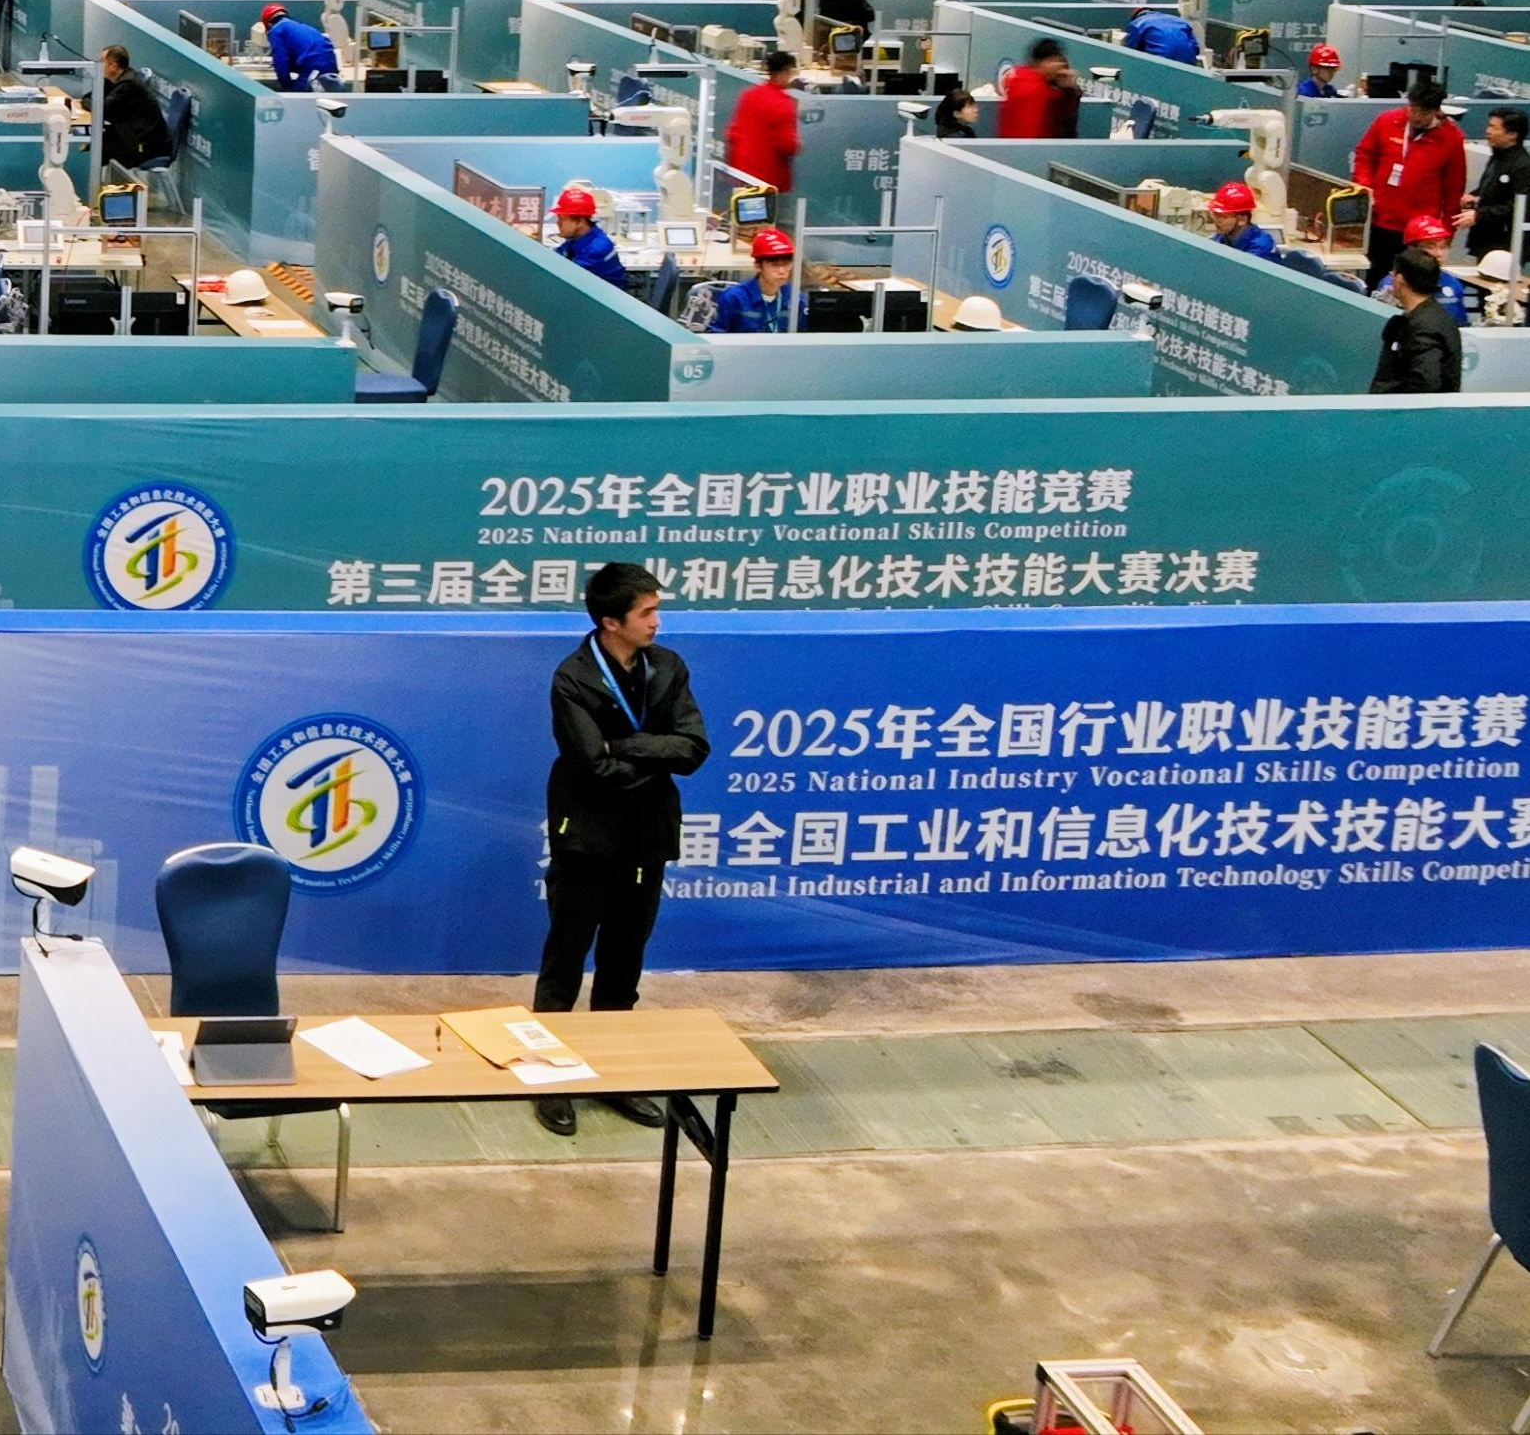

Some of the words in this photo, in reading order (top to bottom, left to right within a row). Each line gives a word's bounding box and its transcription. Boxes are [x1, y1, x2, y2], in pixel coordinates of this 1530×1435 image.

[683, 364, 704, 379] 05
[479, 467, 1134, 519] 2025年全国行业职业技能竞赛
[477, 526, 534, 545] 2025
[542, 526, 648, 545] National
[657, 524, 764, 547] Industry
[773, 522, 901, 542] Vocational
[907, 522, 976, 540] Skills
[984, 521, 1128, 542] Competition
[326, 548, 1260, 607] 第三届全国业和信息化技术技能大赛决赛
[730, 692, 1529, 760] 2025年全国行业职业技能竞赛
[250, 723, 413, 786] 全国工业和信息化技术技能大赛
[727, 771, 796, 794] 2025
[807, 768, 936, 792] National
[948, 766, 1078, 794] Industry
[1089, 761, 1245, 788] Vocational
[1254, 759, 1337, 784] Skills
[1346, 756, 1520, 784] Competition
[539, 796, 1530, 869] 届全国工业和信息化技术技能大
[786, 871, 934, 898] Industrial
[939, 870, 992, 894] and
[1000, 868, 1171, 894] Information
[1177, 863, 1332, 893] Technology
[1339, 860, 1413, 884] Skills
